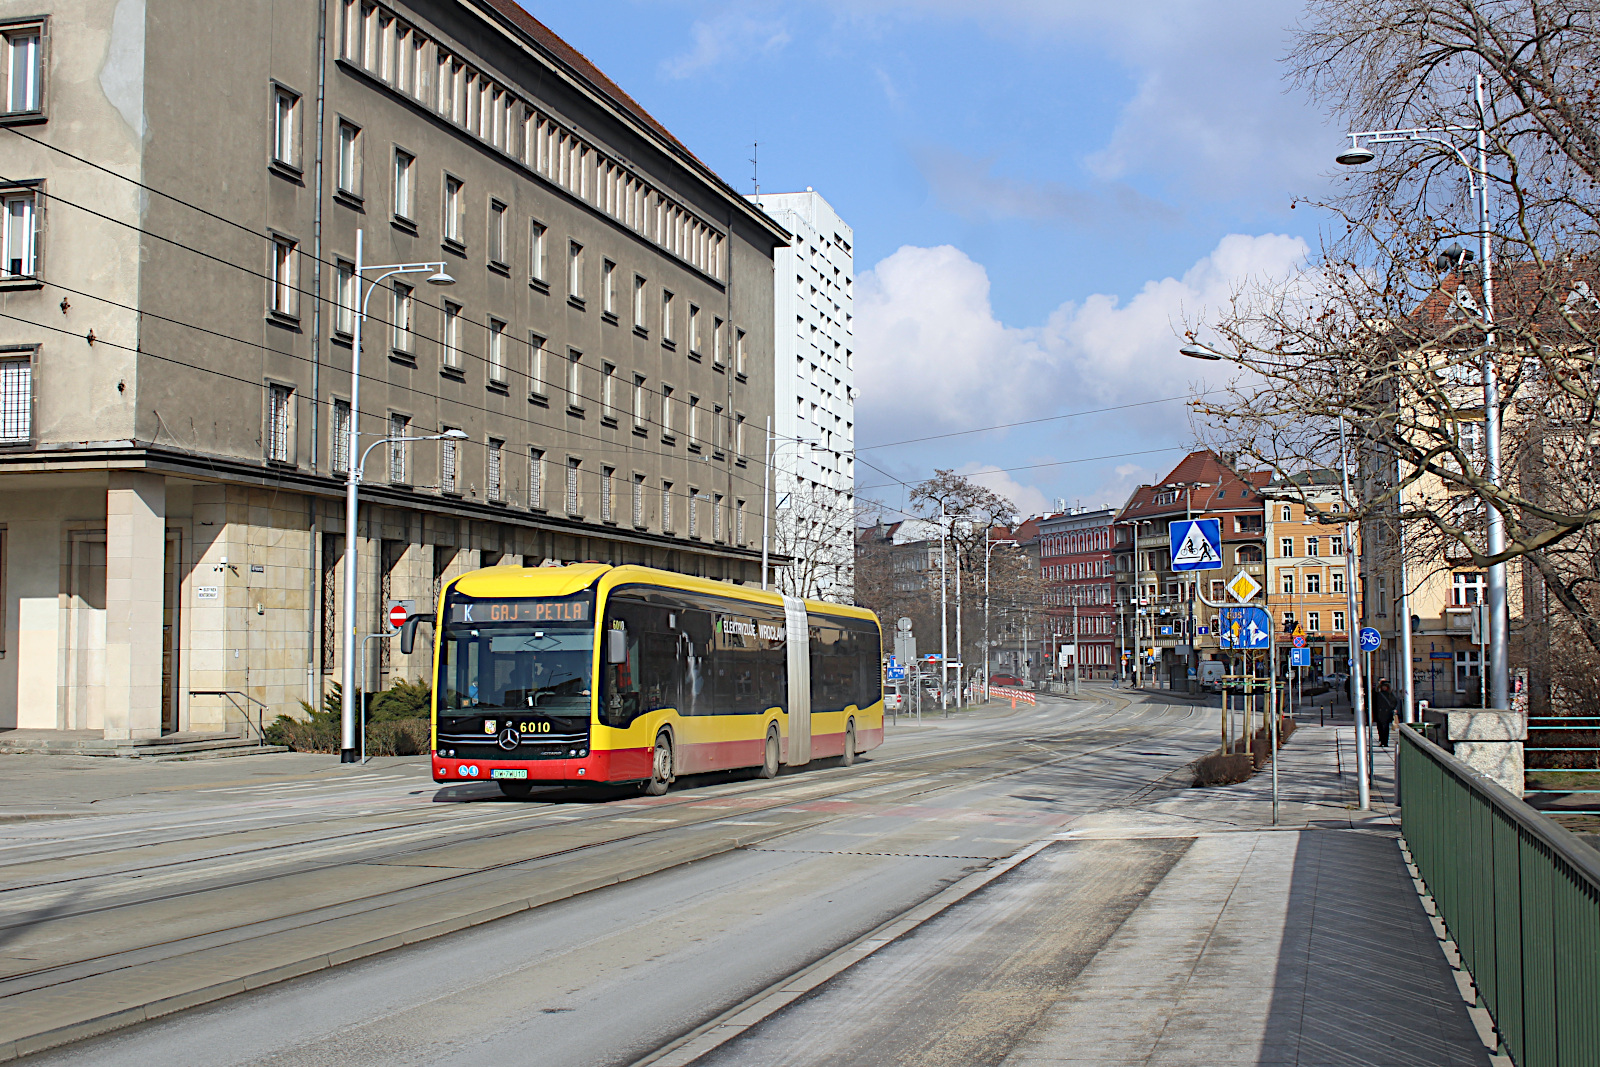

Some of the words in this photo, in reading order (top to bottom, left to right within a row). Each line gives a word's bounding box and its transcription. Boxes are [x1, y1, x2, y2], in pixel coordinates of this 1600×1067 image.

[464, 604, 473, 621] K
[491, 604, 518, 620] GAJ
[536, 603, 582, 620] PĘTLA
[1226, 611, 1243, 619] BUS
[723, 620, 757, 639] ELEKTRYZUJĘ
[759, 624, 785, 641] WROCŁAW
[520, 721, 551, 733] 6010
